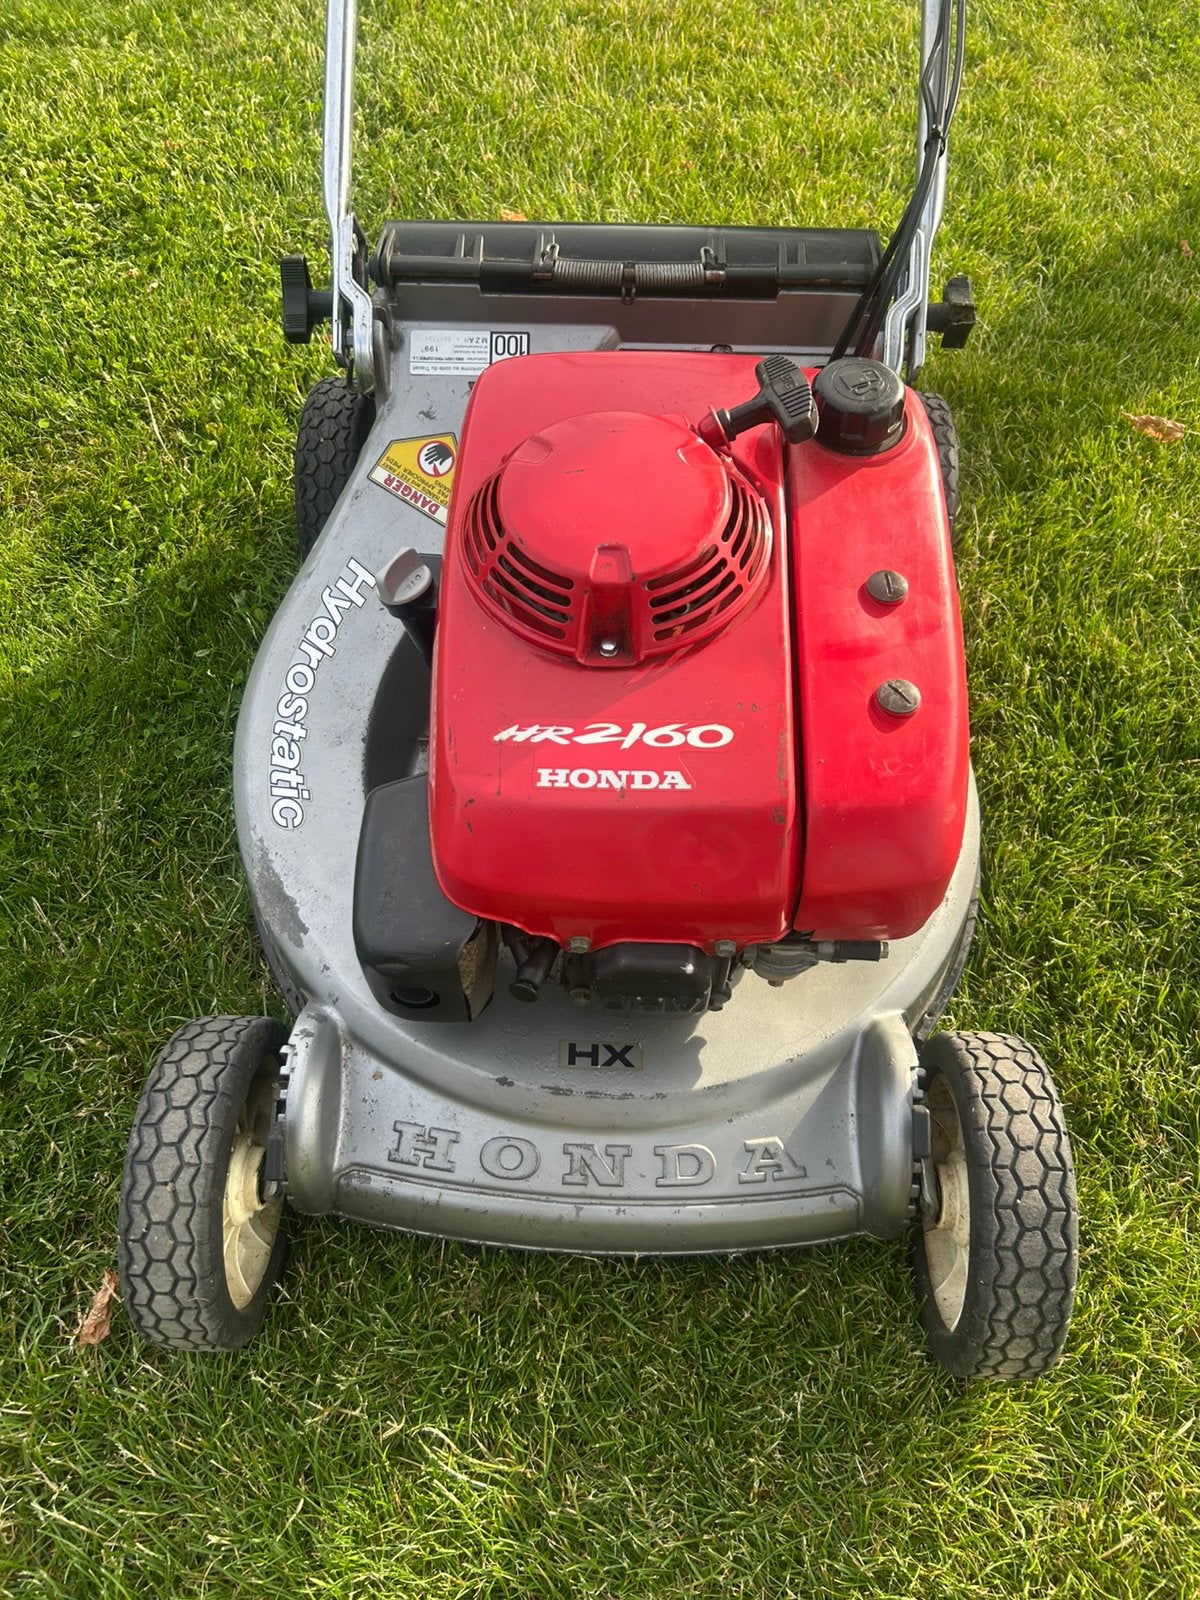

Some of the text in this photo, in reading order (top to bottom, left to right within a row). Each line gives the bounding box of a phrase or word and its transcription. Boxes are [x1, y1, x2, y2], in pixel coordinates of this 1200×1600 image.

[495, 335, 525, 356] 100
[382, 462, 397, 474] AWAY
[385, 456, 402, 470] PIEDS
[398, 472, 411, 483] FEET
[403, 468, 435, 490] APPROCHER
[384, 474, 440, 515] DANGER
[422, 486, 440, 501] HANDS
[270, 557, 378, 828] Hydrostatic
[492, 722, 734, 749] HR2160
[536, 768, 692, 790] HONDA
[568, 1042, 635, 1068] HX
[387, 1120, 807, 1187] HONDA
